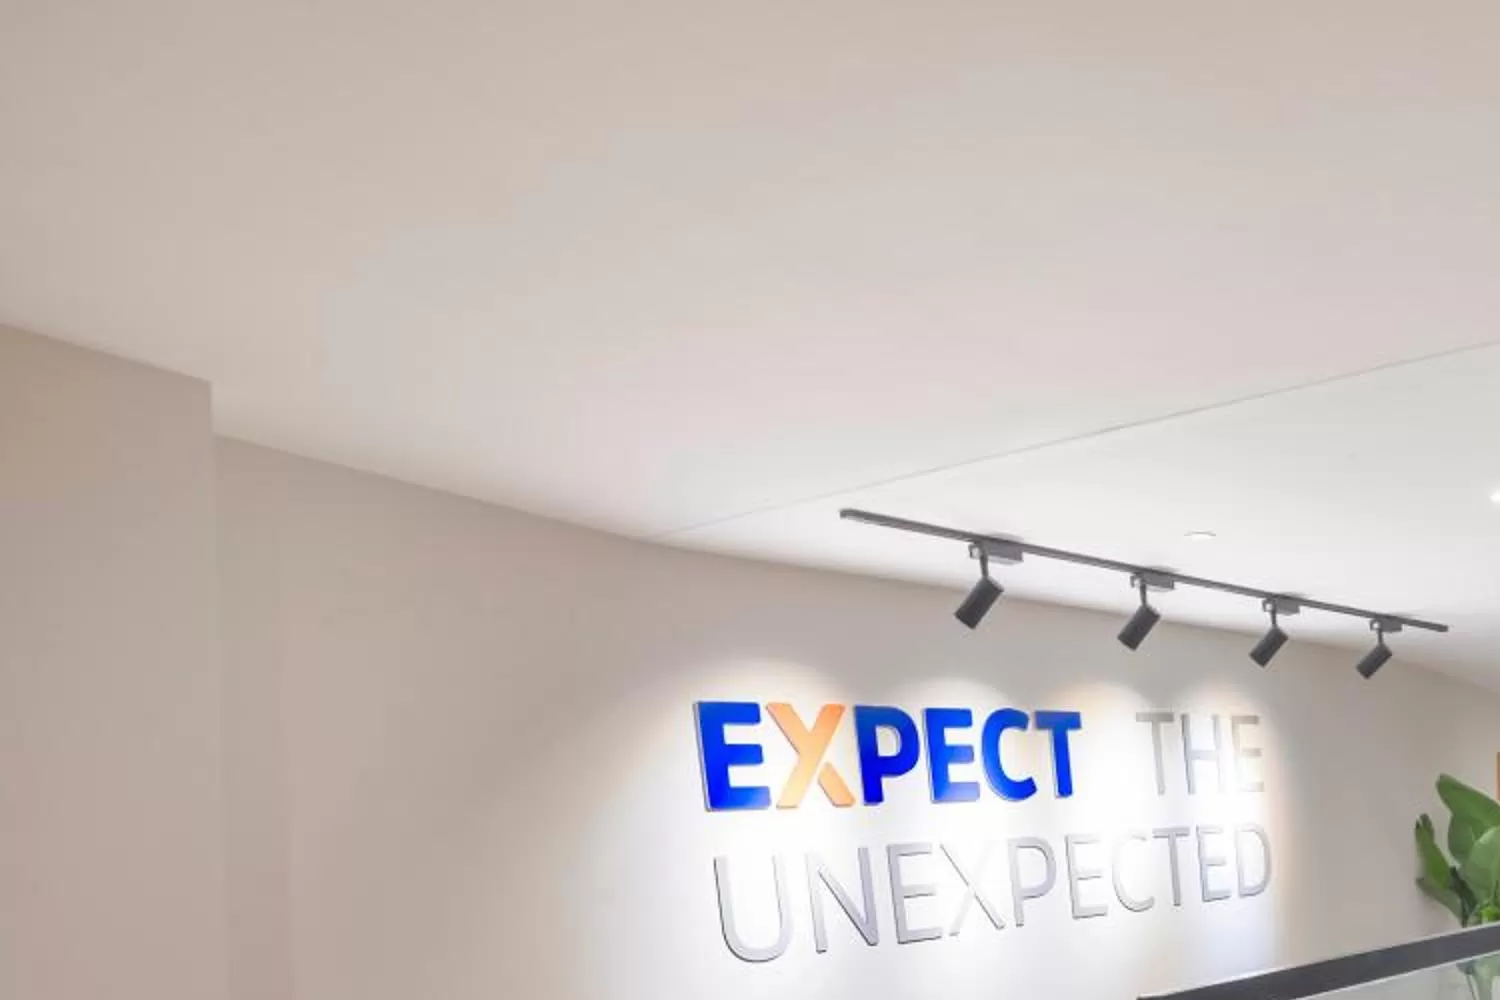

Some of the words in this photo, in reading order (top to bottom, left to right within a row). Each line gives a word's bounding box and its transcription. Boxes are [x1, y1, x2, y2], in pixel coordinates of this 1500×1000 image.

[692, 700, 1083, 812] EXPECT
[1135, 711, 1266, 796] THE
[713, 823, 1274, 963] UNEXPECTED
